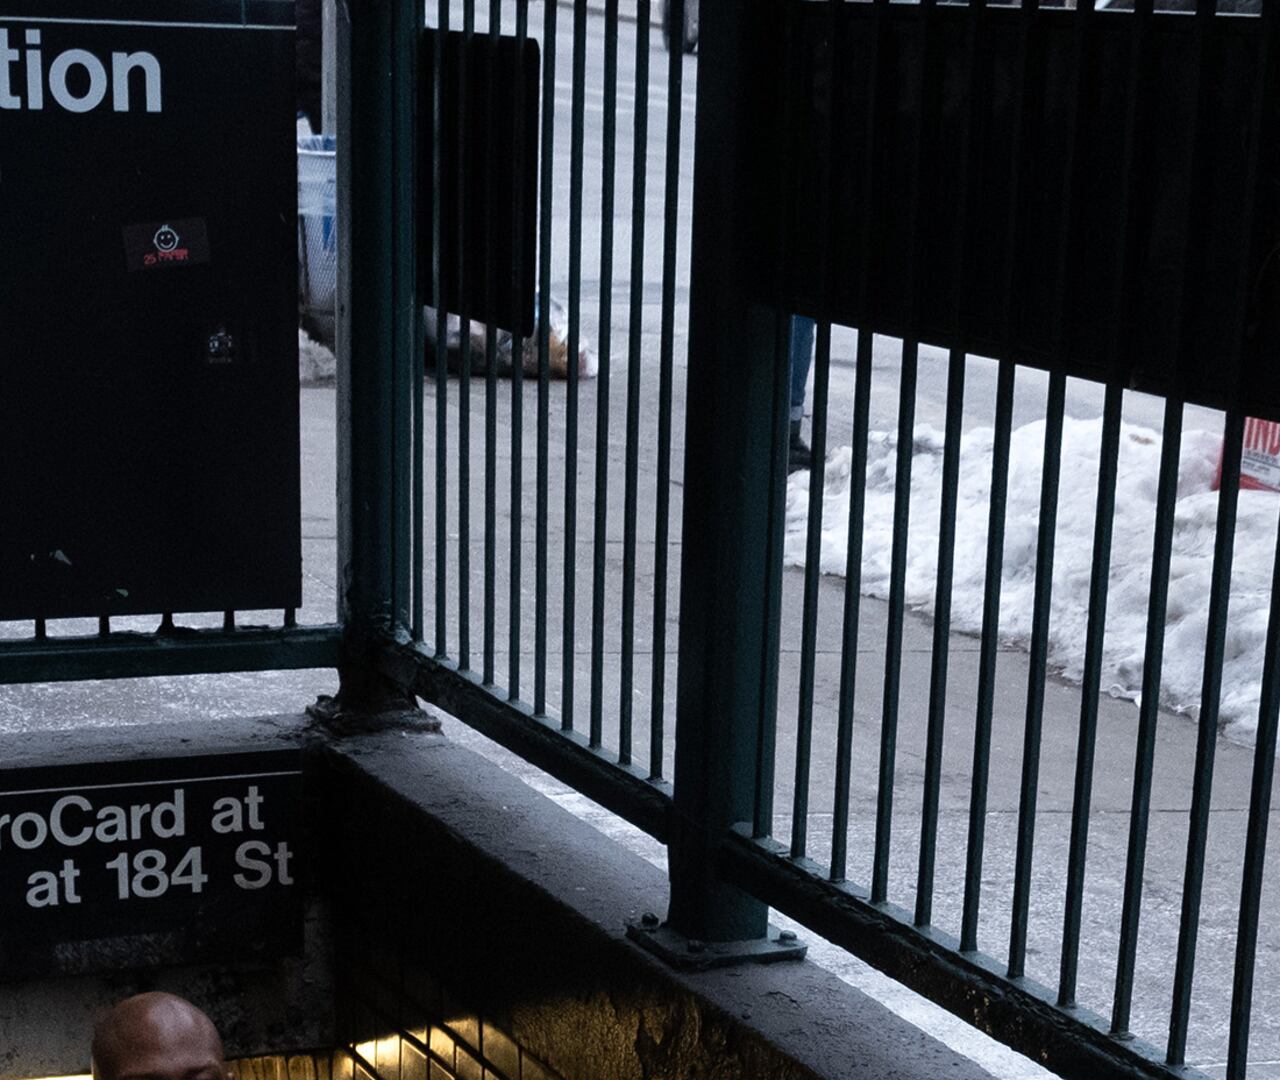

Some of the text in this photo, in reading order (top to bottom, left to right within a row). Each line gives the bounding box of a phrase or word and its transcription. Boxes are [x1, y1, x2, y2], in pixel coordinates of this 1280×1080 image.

[211, 786, 265, 833] at
[26, 859, 81, 908] at
[106, 846, 208, 899] 184
[233, 837, 293, 891] St
